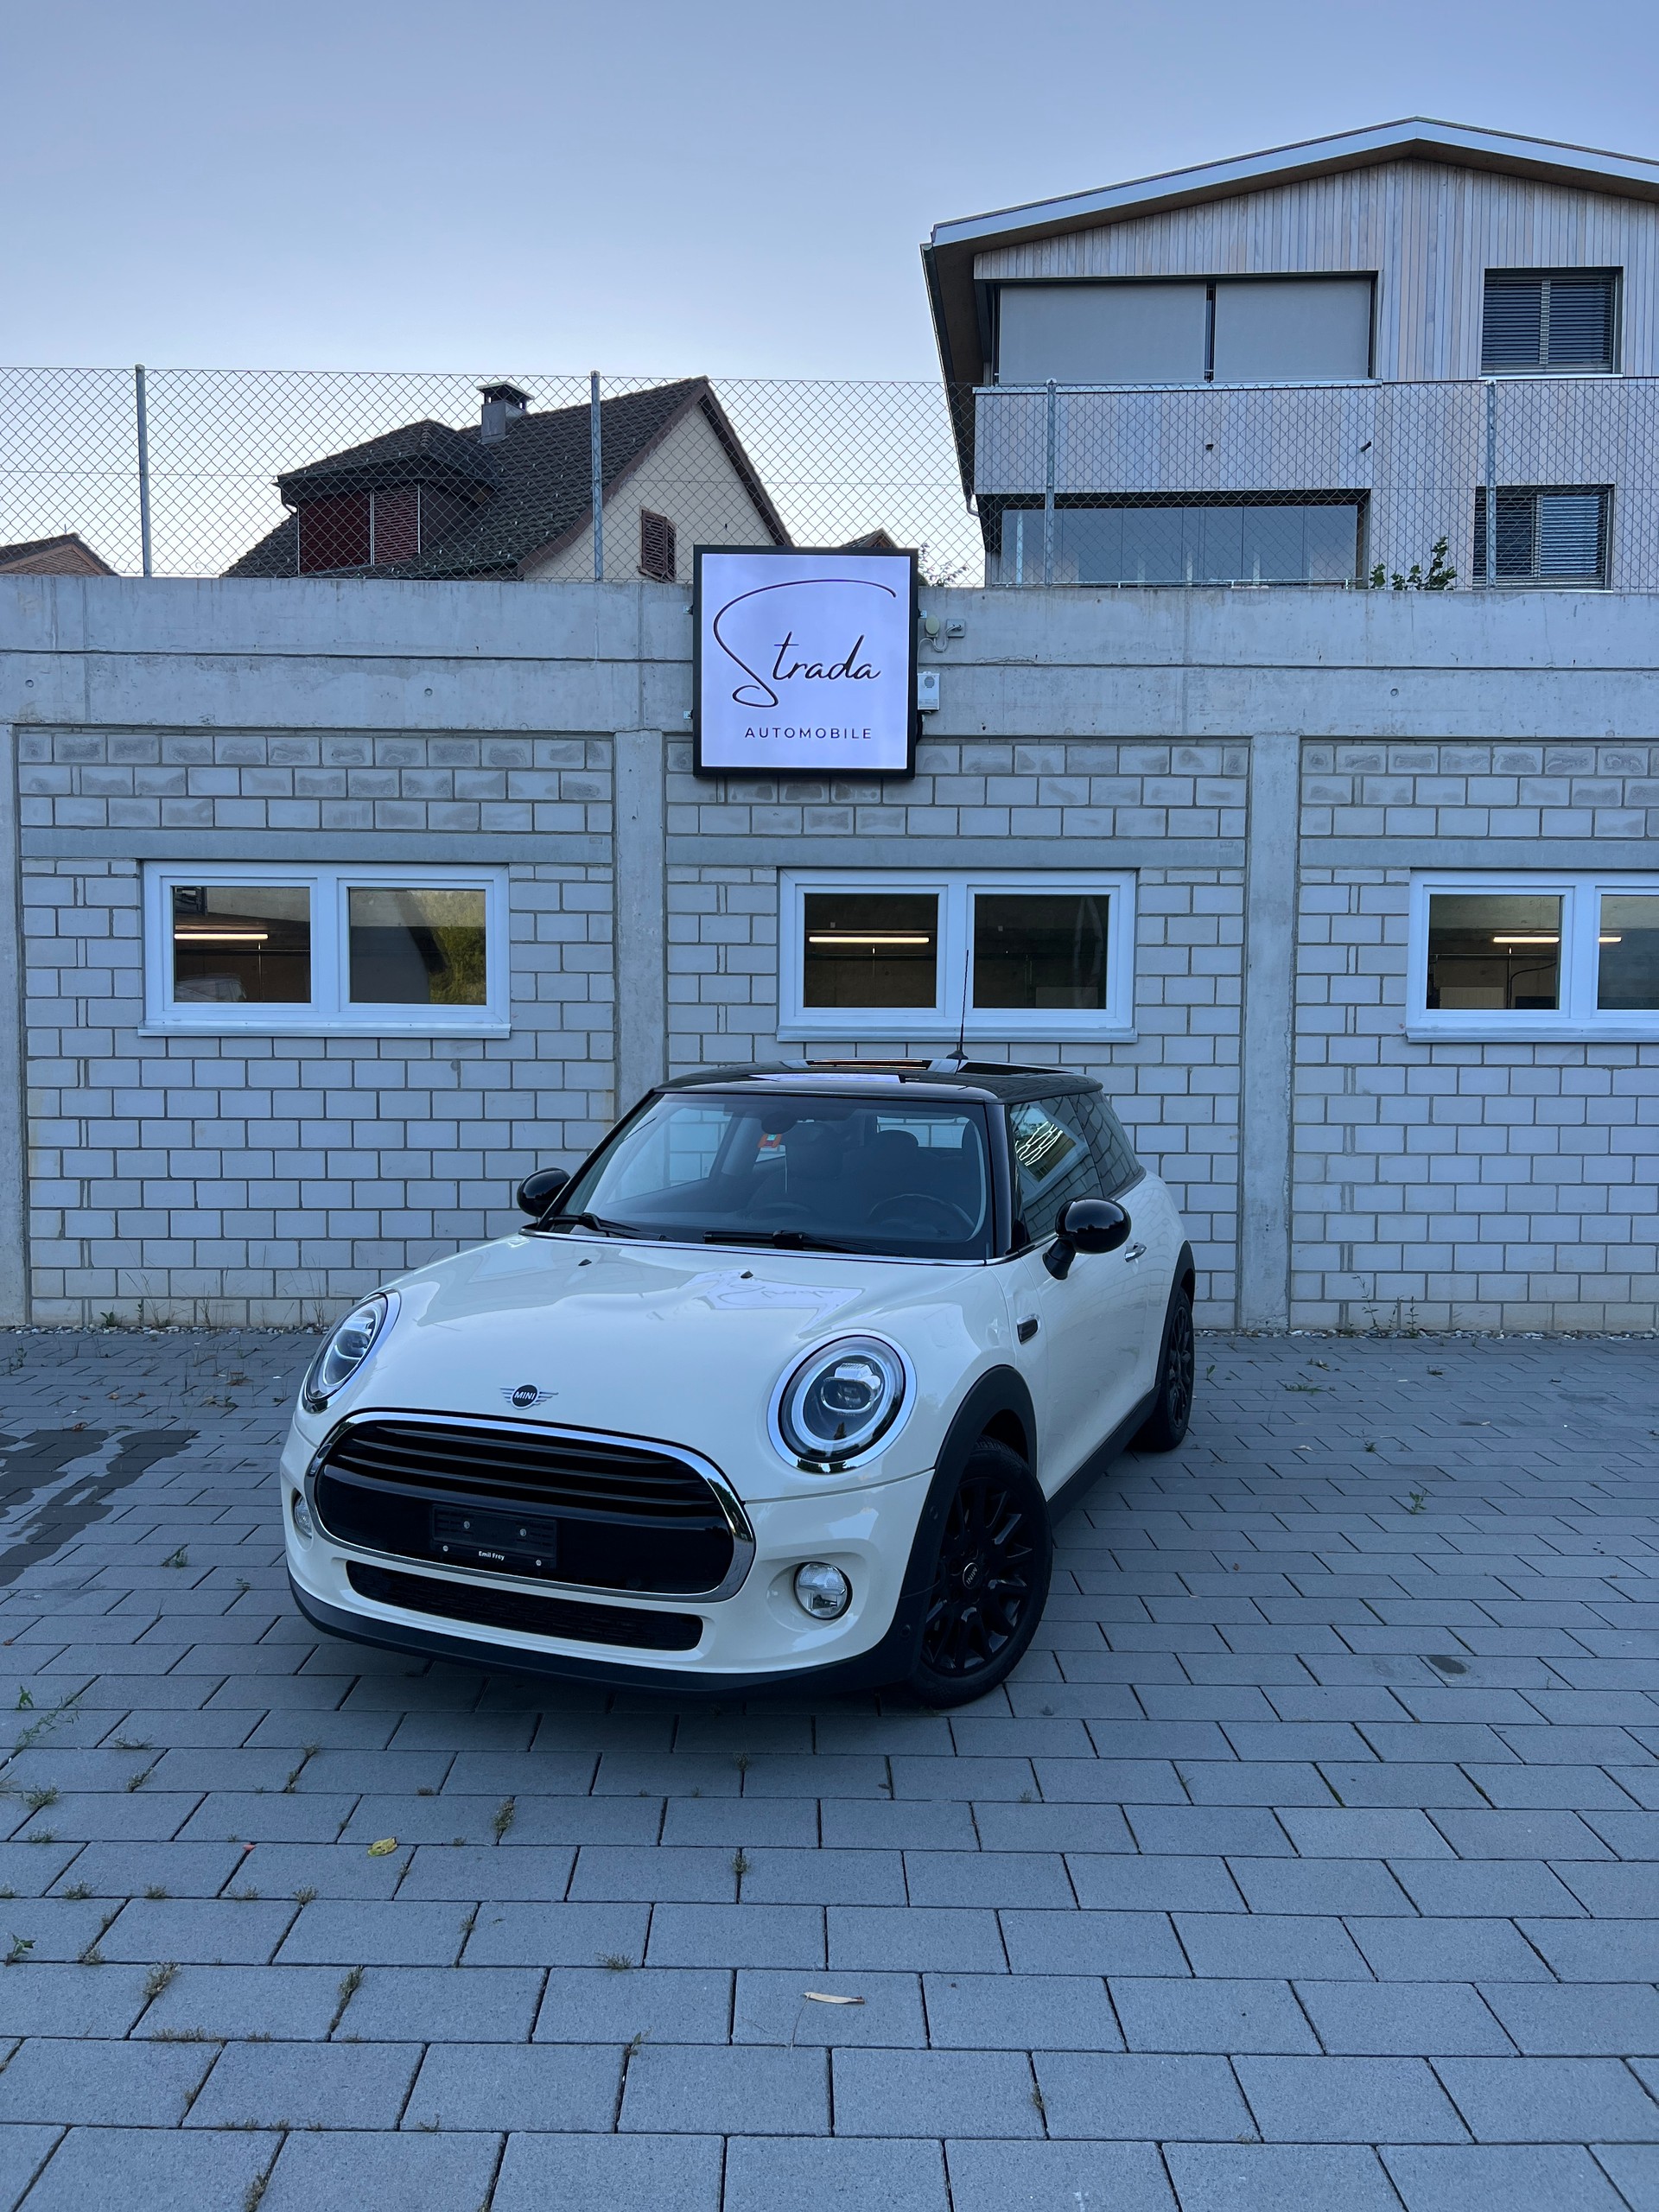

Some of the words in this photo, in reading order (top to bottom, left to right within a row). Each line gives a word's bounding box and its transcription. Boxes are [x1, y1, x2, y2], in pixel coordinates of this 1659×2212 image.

[713, 579, 897, 708] Strada
[744, 727, 872, 740] AUTOMOBILE
[514, 1391, 537, 1401] MINI
[492, 1552, 505, 1561] Frey
[966, 1567, 977, 1585] MINI
